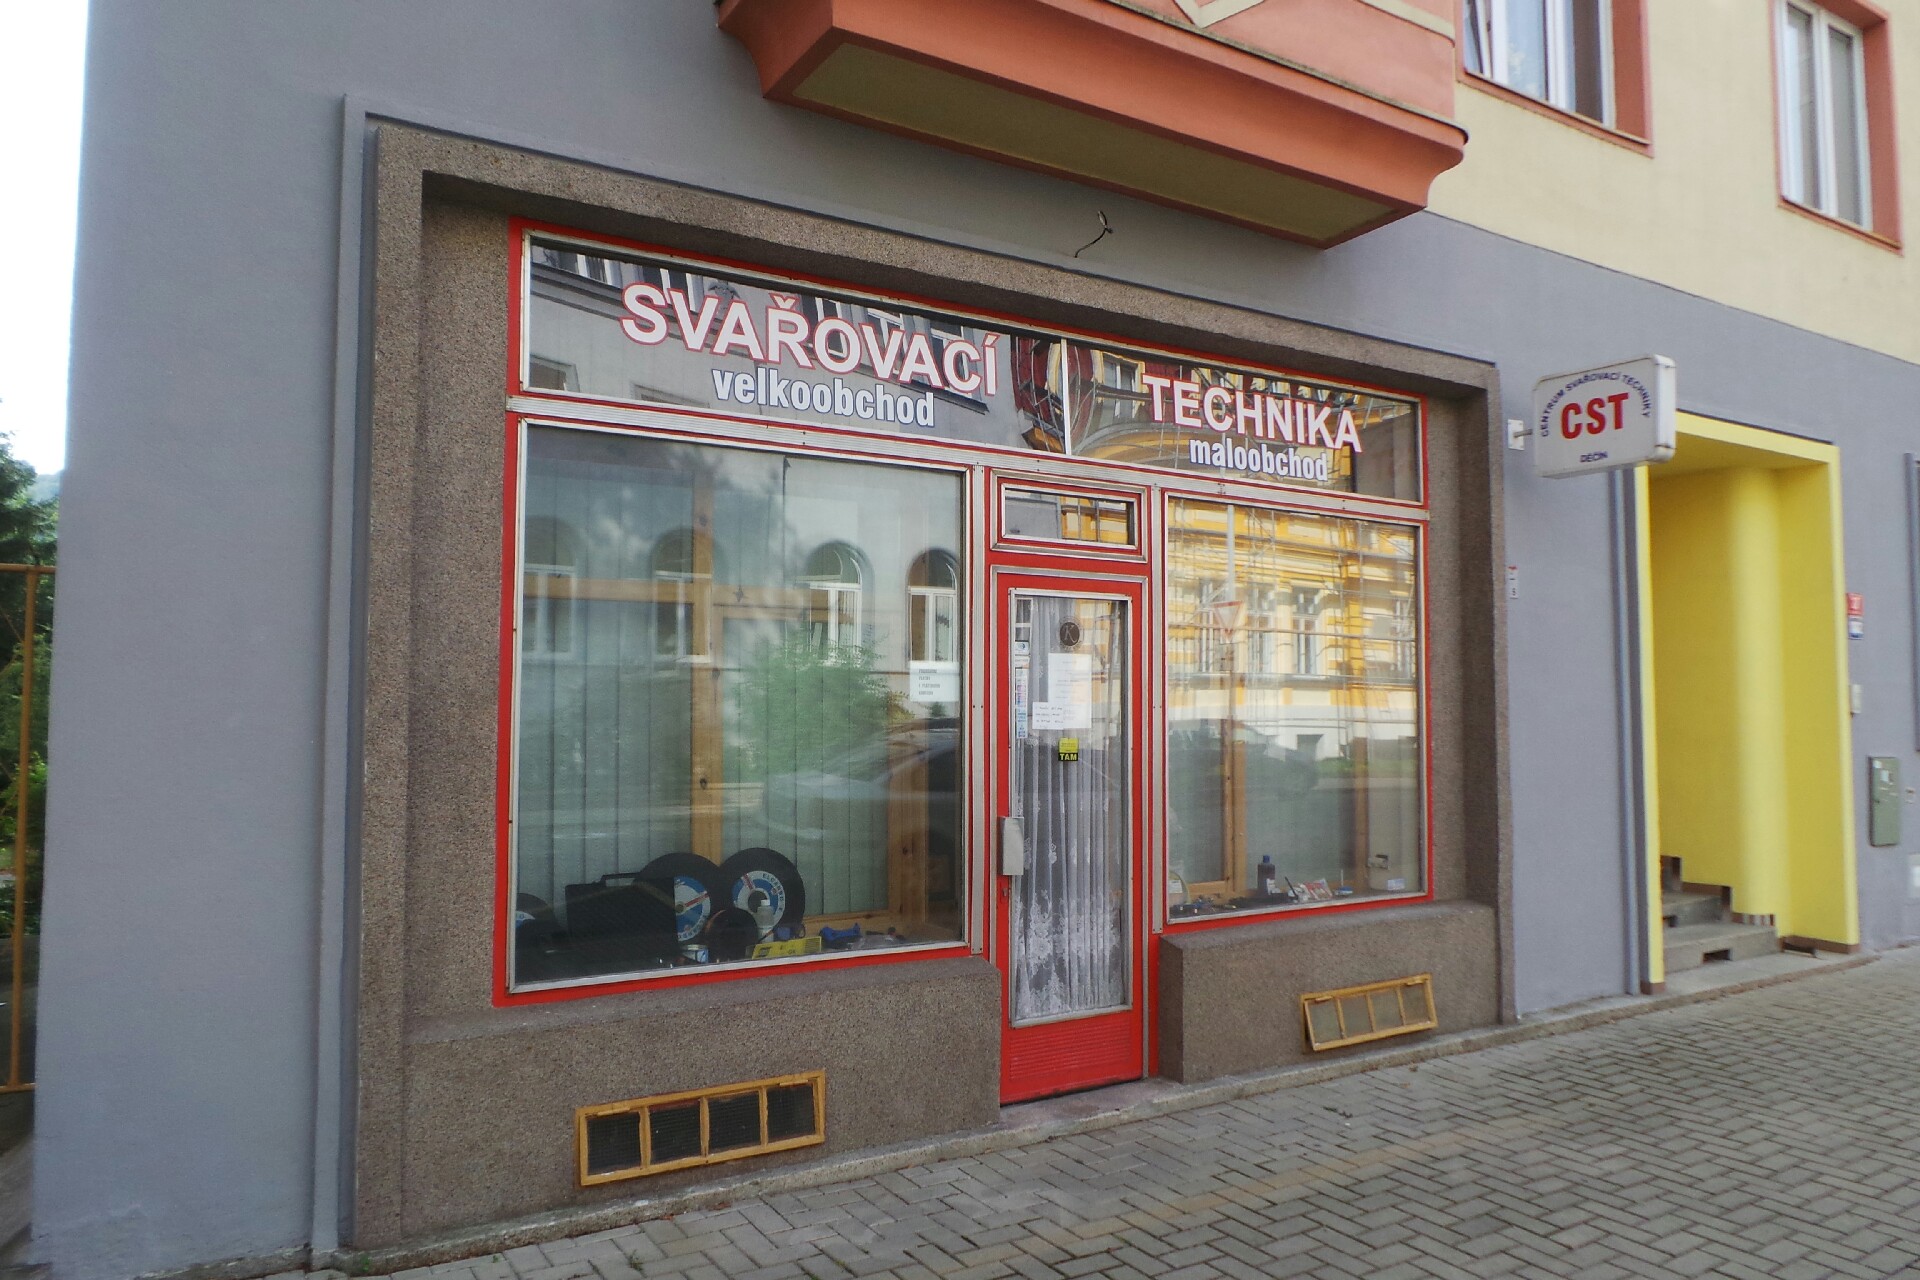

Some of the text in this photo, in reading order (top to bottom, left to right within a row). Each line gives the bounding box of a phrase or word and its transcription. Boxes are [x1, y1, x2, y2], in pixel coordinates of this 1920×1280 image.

[618, 282, 998, 397] SVAŘOVACÍ
[712, 367, 936, 428] velkoobchod
[1142, 374, 1363, 453] TECHNIKA
[1541, 389, 1564, 437] CENTRUM
[1623, 375, 1652, 418] TECHNIKY
[1561, 392, 1629, 439] CST
[1189, 437, 1328, 482] maloobchod
[1059, 753, 1078, 761] TAM
